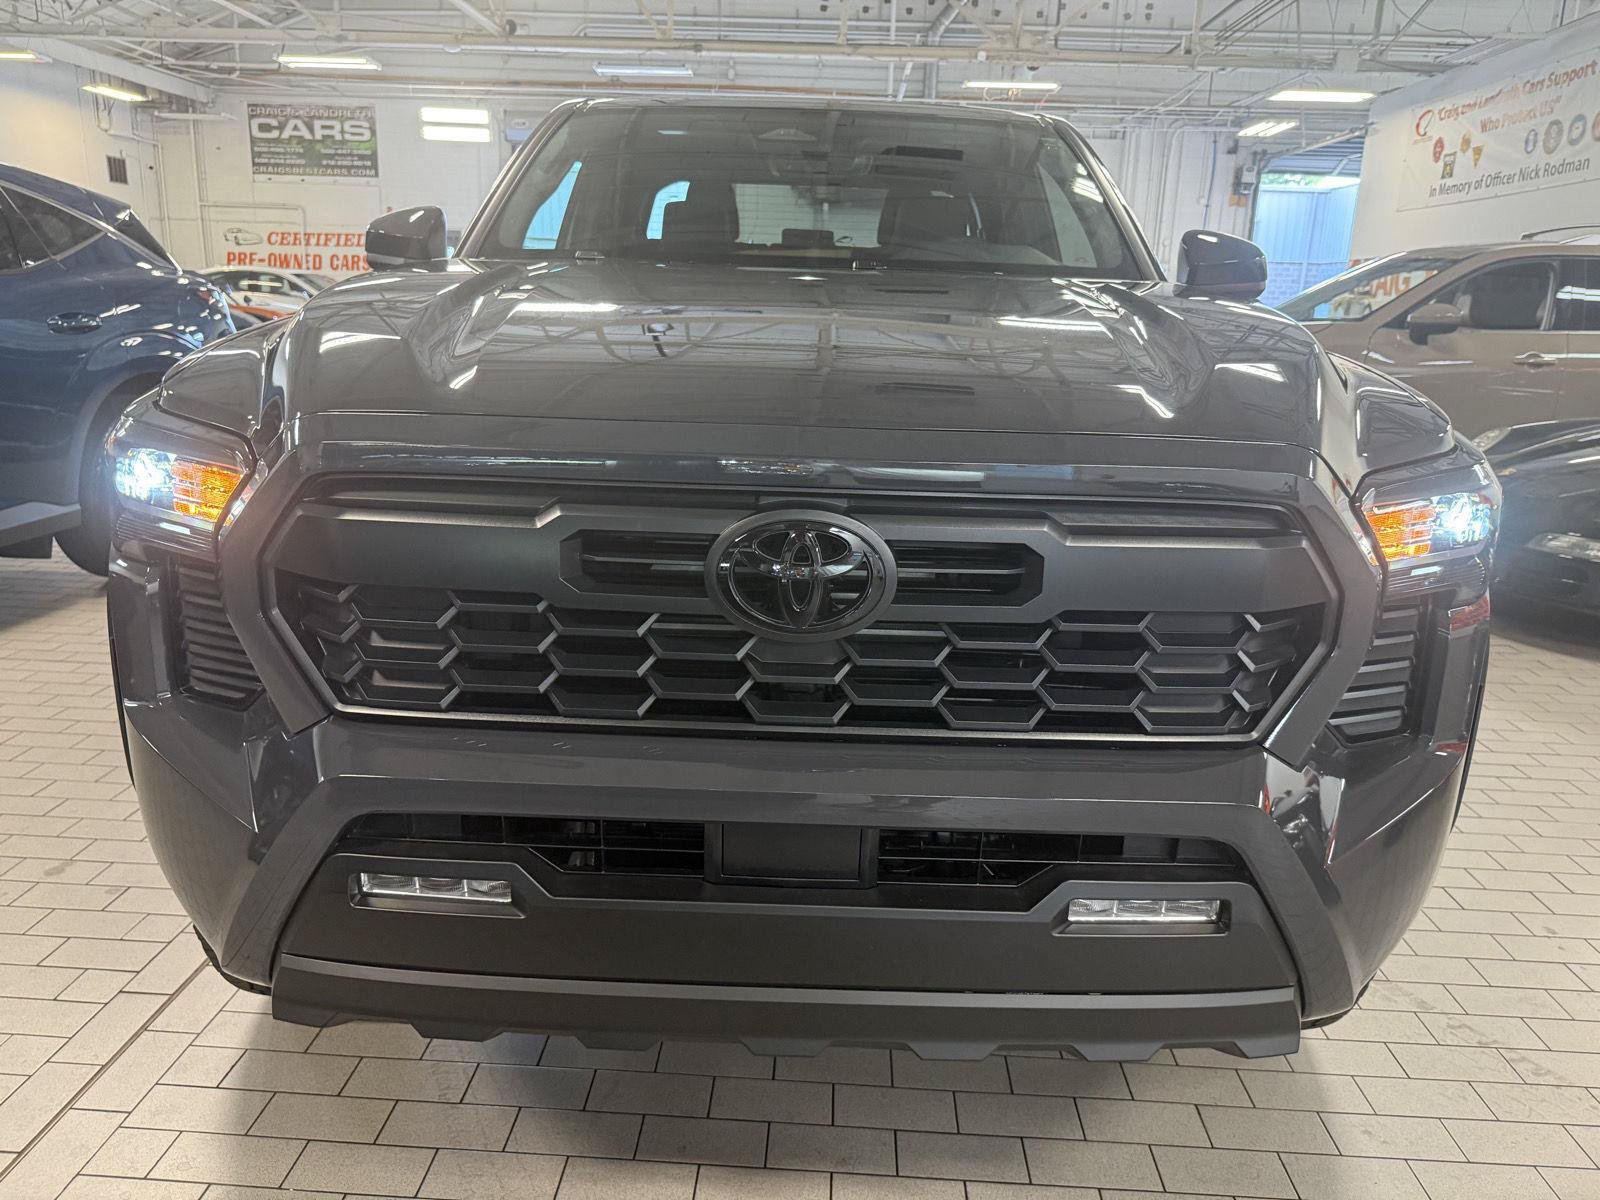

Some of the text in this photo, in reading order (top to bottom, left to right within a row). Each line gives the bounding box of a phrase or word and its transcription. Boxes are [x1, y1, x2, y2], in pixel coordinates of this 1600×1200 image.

[1522, 80, 1546, 95] Cars
[1546, 60, 1597, 89] Support
[250, 118, 371, 141] CARS
[1480, 115, 1500, 134] Who
[1429, 157, 1591, 198] In Memory of Officer Nick Rodman
[227, 251, 370, 272] PRE-OWNED CARS
